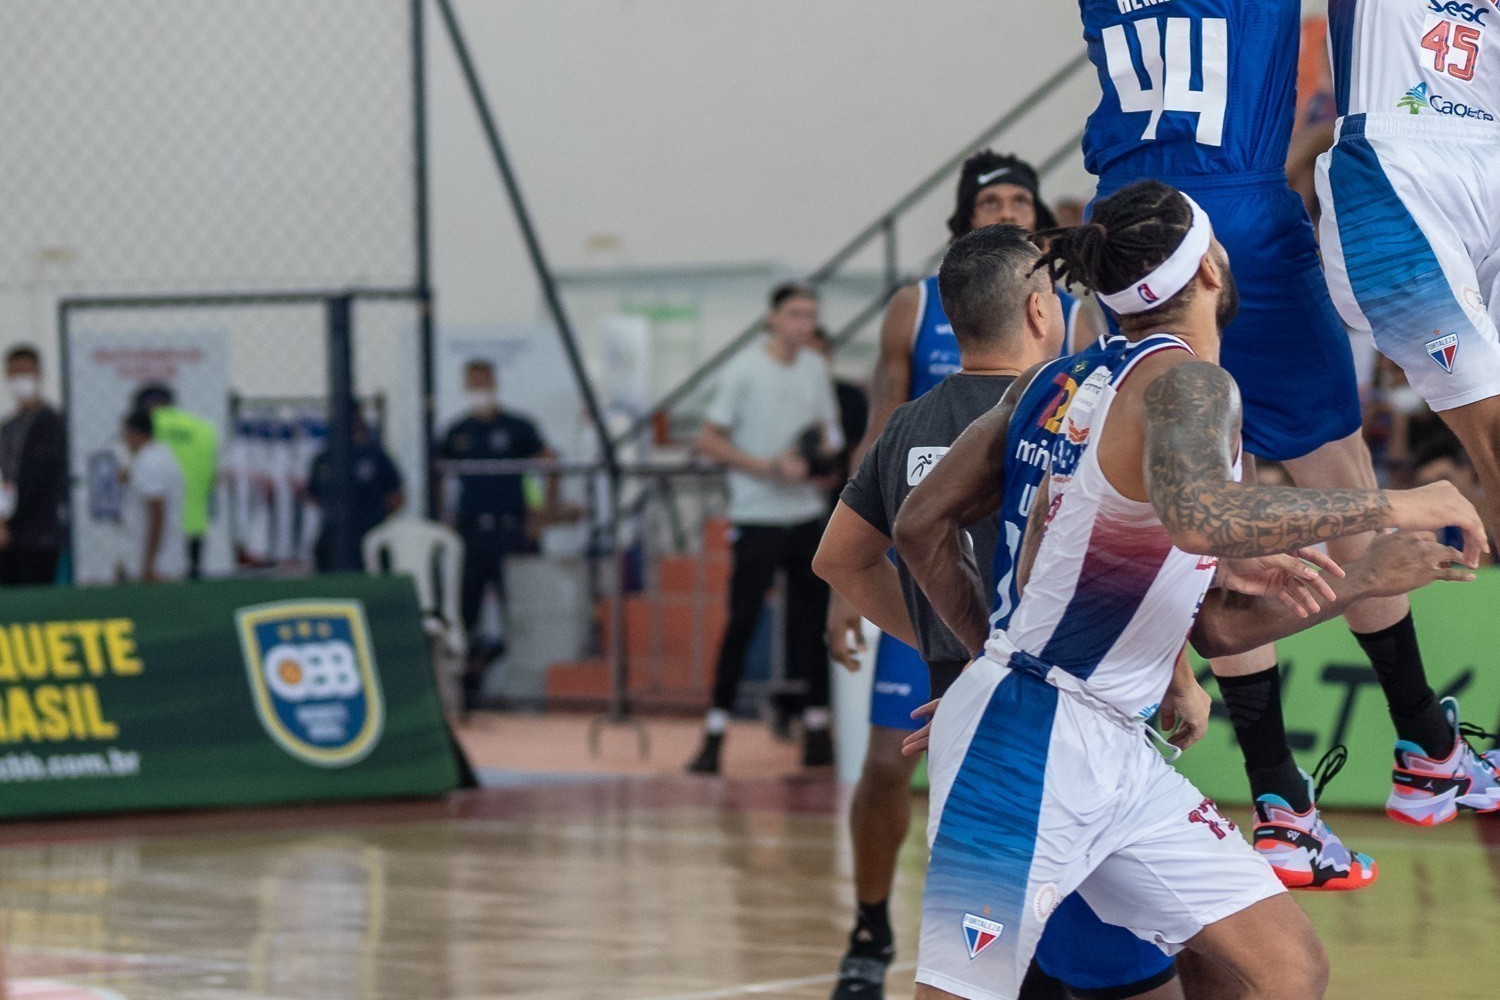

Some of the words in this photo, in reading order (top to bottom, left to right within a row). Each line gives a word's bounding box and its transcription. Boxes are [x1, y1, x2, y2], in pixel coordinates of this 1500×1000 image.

[1421, 20, 1481, 81] 45
[1102, 17, 1228, 148] 44
[1427, 335, 1457, 351] FORTALEZA
